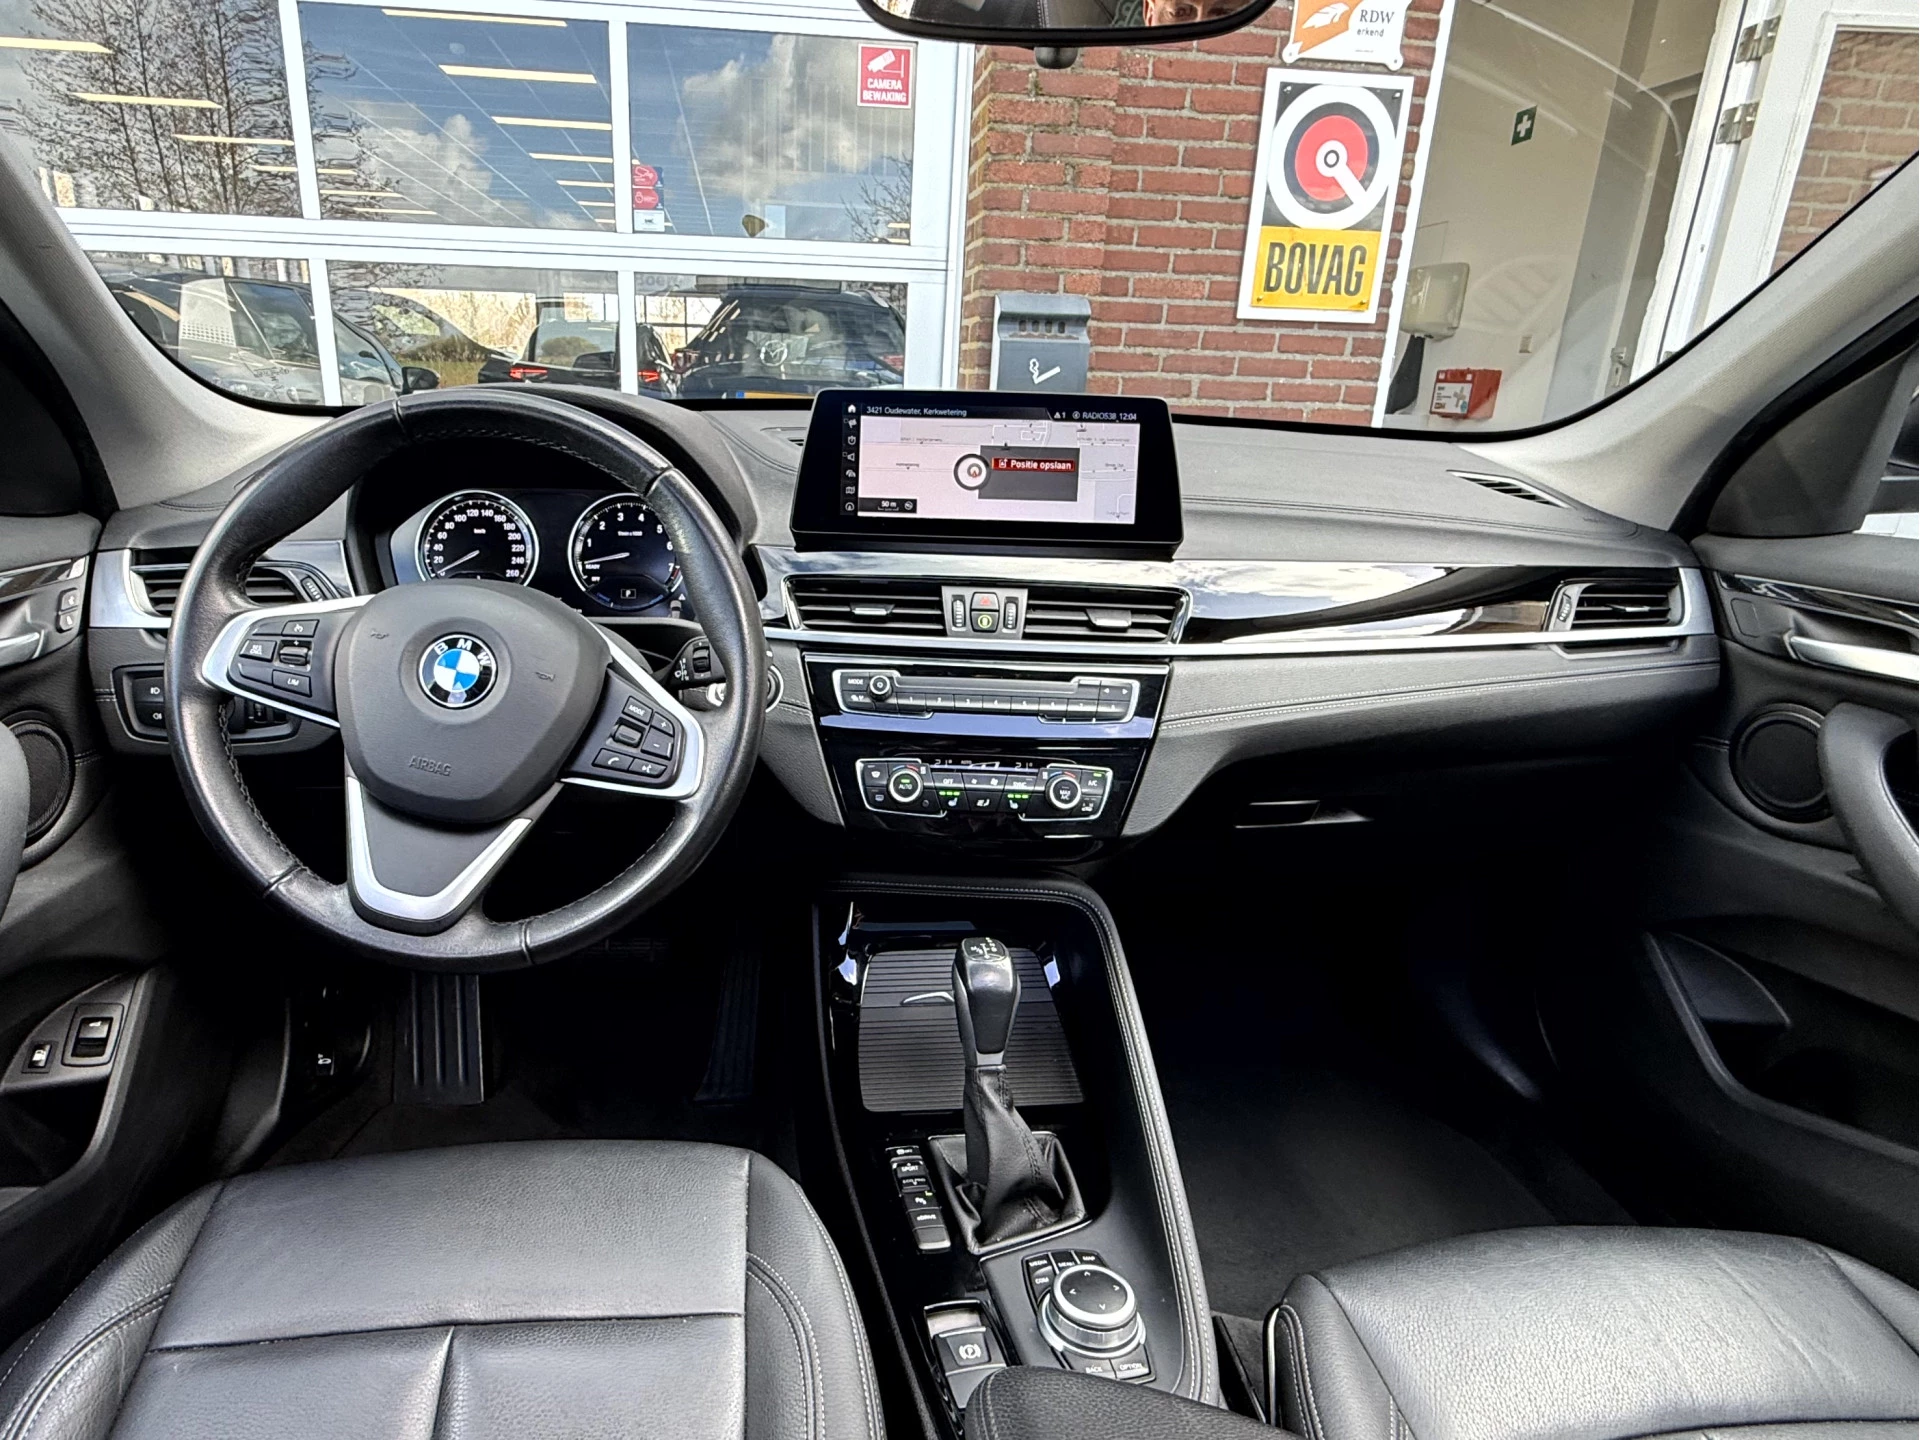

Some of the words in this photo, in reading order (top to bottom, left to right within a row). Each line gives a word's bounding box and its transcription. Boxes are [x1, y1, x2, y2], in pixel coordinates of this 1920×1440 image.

[1359, 9, 1395, 24] RDW
[1356, 28, 1384, 37] erkend
[867, 78, 902, 90] CAMERA
[862, 90, 906, 102] BEWAKING
[1263, 242, 1367, 296] BOVAG
[866, 406, 882, 414] 3421
[924, 408, 968, 416] Kerkwetering
[1010, 460, 1037, 469] Positie
[1040, 462, 1072, 470] opslaan
[466, 509, 479, 517] 120
[617, 512, 624, 521] 3
[638, 513, 644, 521] 4
[454, 514, 467, 522] 100
[503, 522, 516, 530] 180
[599, 521, 605, 530] 2
[657, 525, 663, 533] 5
[587, 538, 592, 547] 1
[666, 541, 673, 550] 6
[511, 544, 524, 552] 220
[668, 563, 674, 572] 7
[506, 569, 520, 577] 260
[433, 638, 492, 667] BMW
[287, 678, 300, 686] LIM
[628, 704, 646, 716] MODE
[408, 754, 452, 776] AIRBAG
